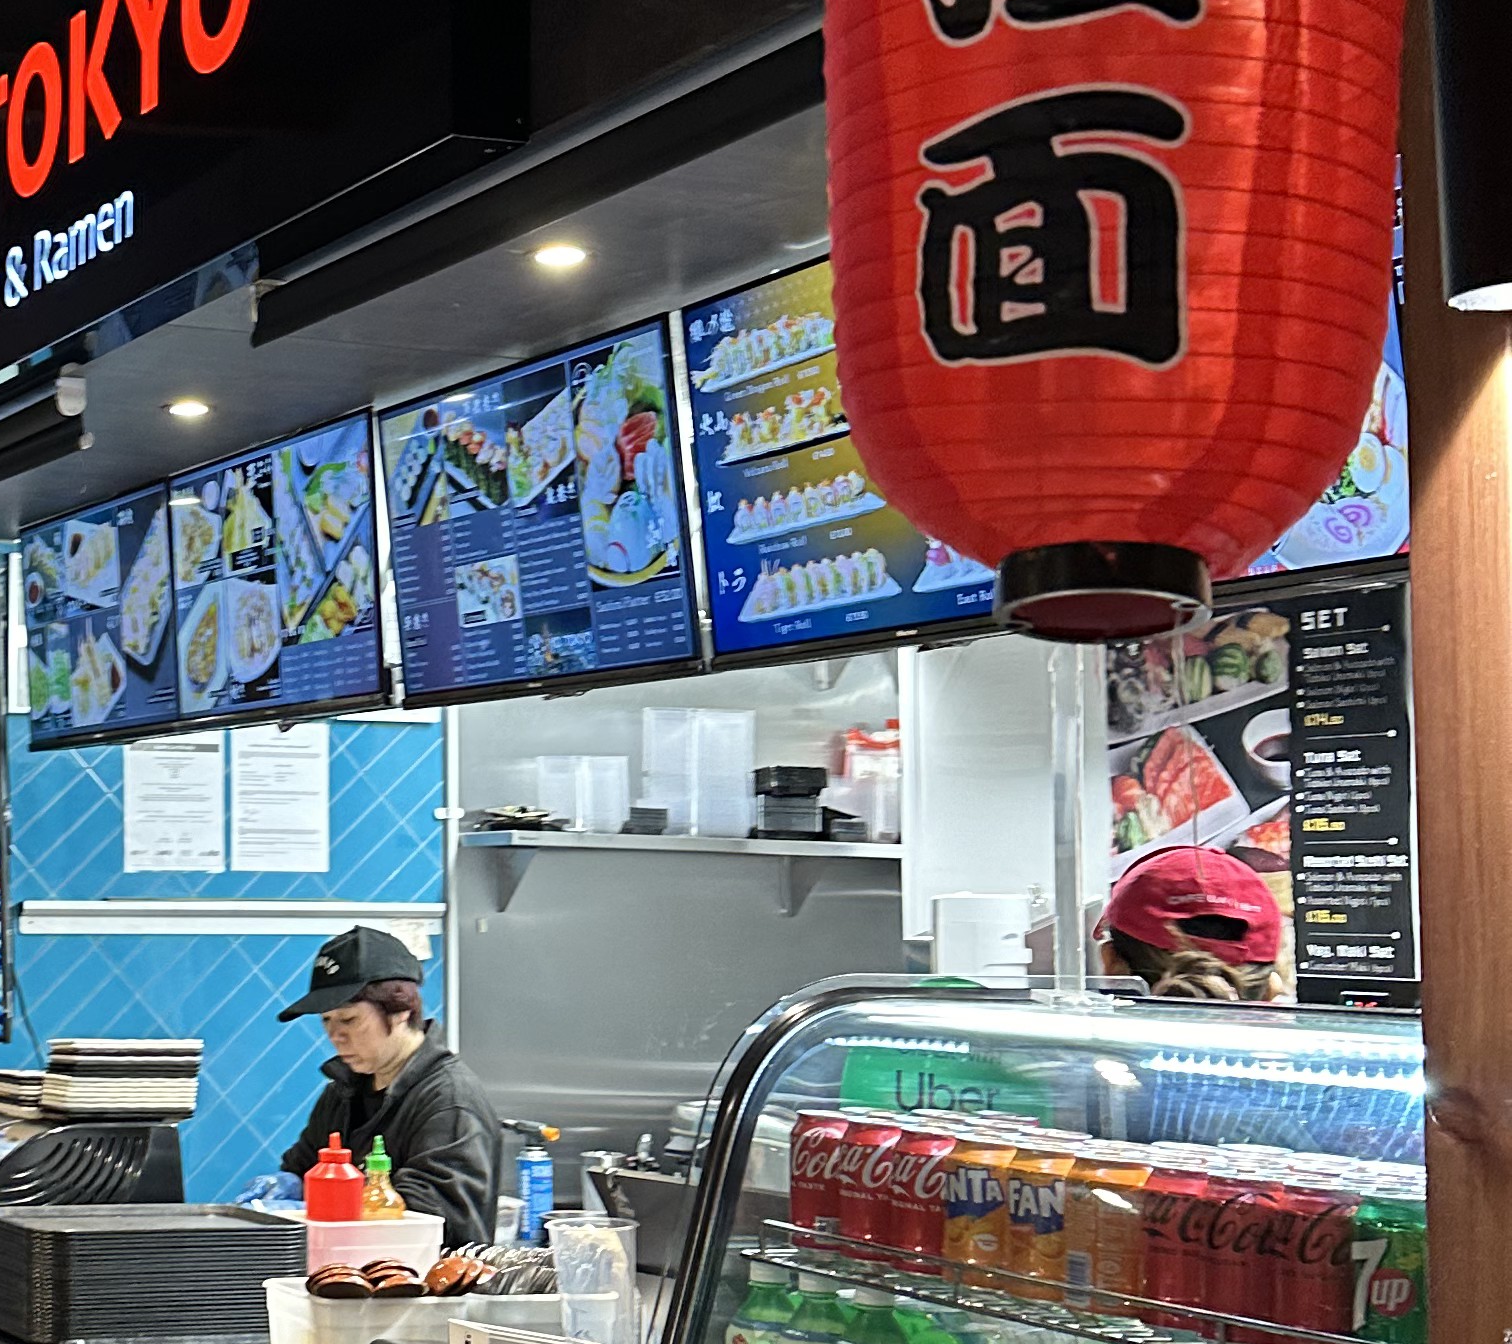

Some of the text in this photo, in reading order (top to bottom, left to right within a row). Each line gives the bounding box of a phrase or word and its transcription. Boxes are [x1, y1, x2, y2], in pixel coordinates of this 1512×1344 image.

[3, 245, 29, 307] &
[32, 189, 135, 292] Ramen
[1299, 606, 1349, 632] SET
[895, 1069, 999, 1112] Uber
